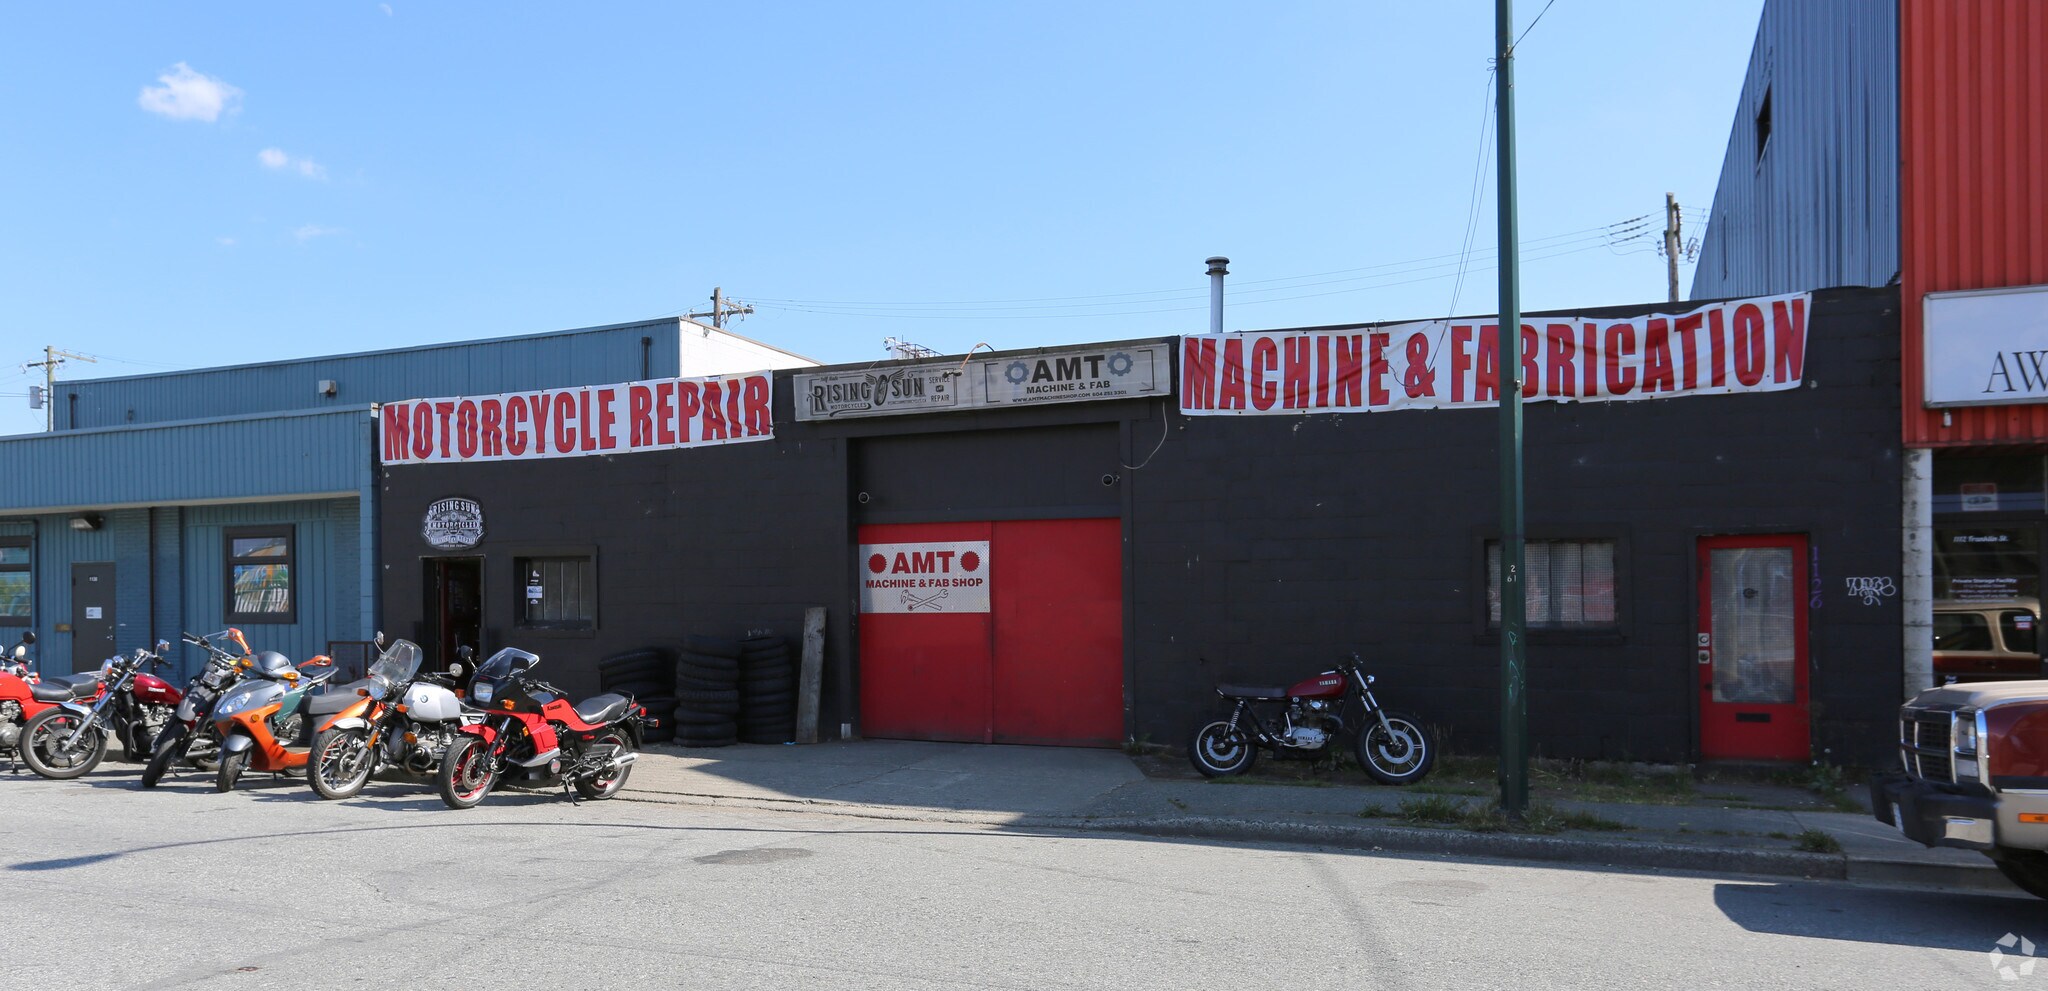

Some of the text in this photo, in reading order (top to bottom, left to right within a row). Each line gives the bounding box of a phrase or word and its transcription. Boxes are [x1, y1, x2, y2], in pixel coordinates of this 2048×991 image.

[1182, 298, 1805, 411] MACHINE & FABRICATION
[1031, 355, 1105, 383] AMT
[1026, 383, 1075, 394] MACHINE
[1089, 380, 1111, 389] FAB
[808, 377, 926, 412] RISING SUN
[930, 394, 950, 402] REPAIR
[1012, 392, 1090, 403] WWW.AMTMACHINESHOP.COM
[830, 402, 867, 410] MOTORCYCLES
[384, 375, 772, 461] MOTORCYCLE REPAIR
[433, 501, 476, 514] RISING SUN
[432, 522, 476, 530] MOTORCYCLES
[891, 551, 955, 574] AMT
[1510, 564, 1516, 572] 2
[865, 578, 983, 589] MACHINE & FAB SHOP
